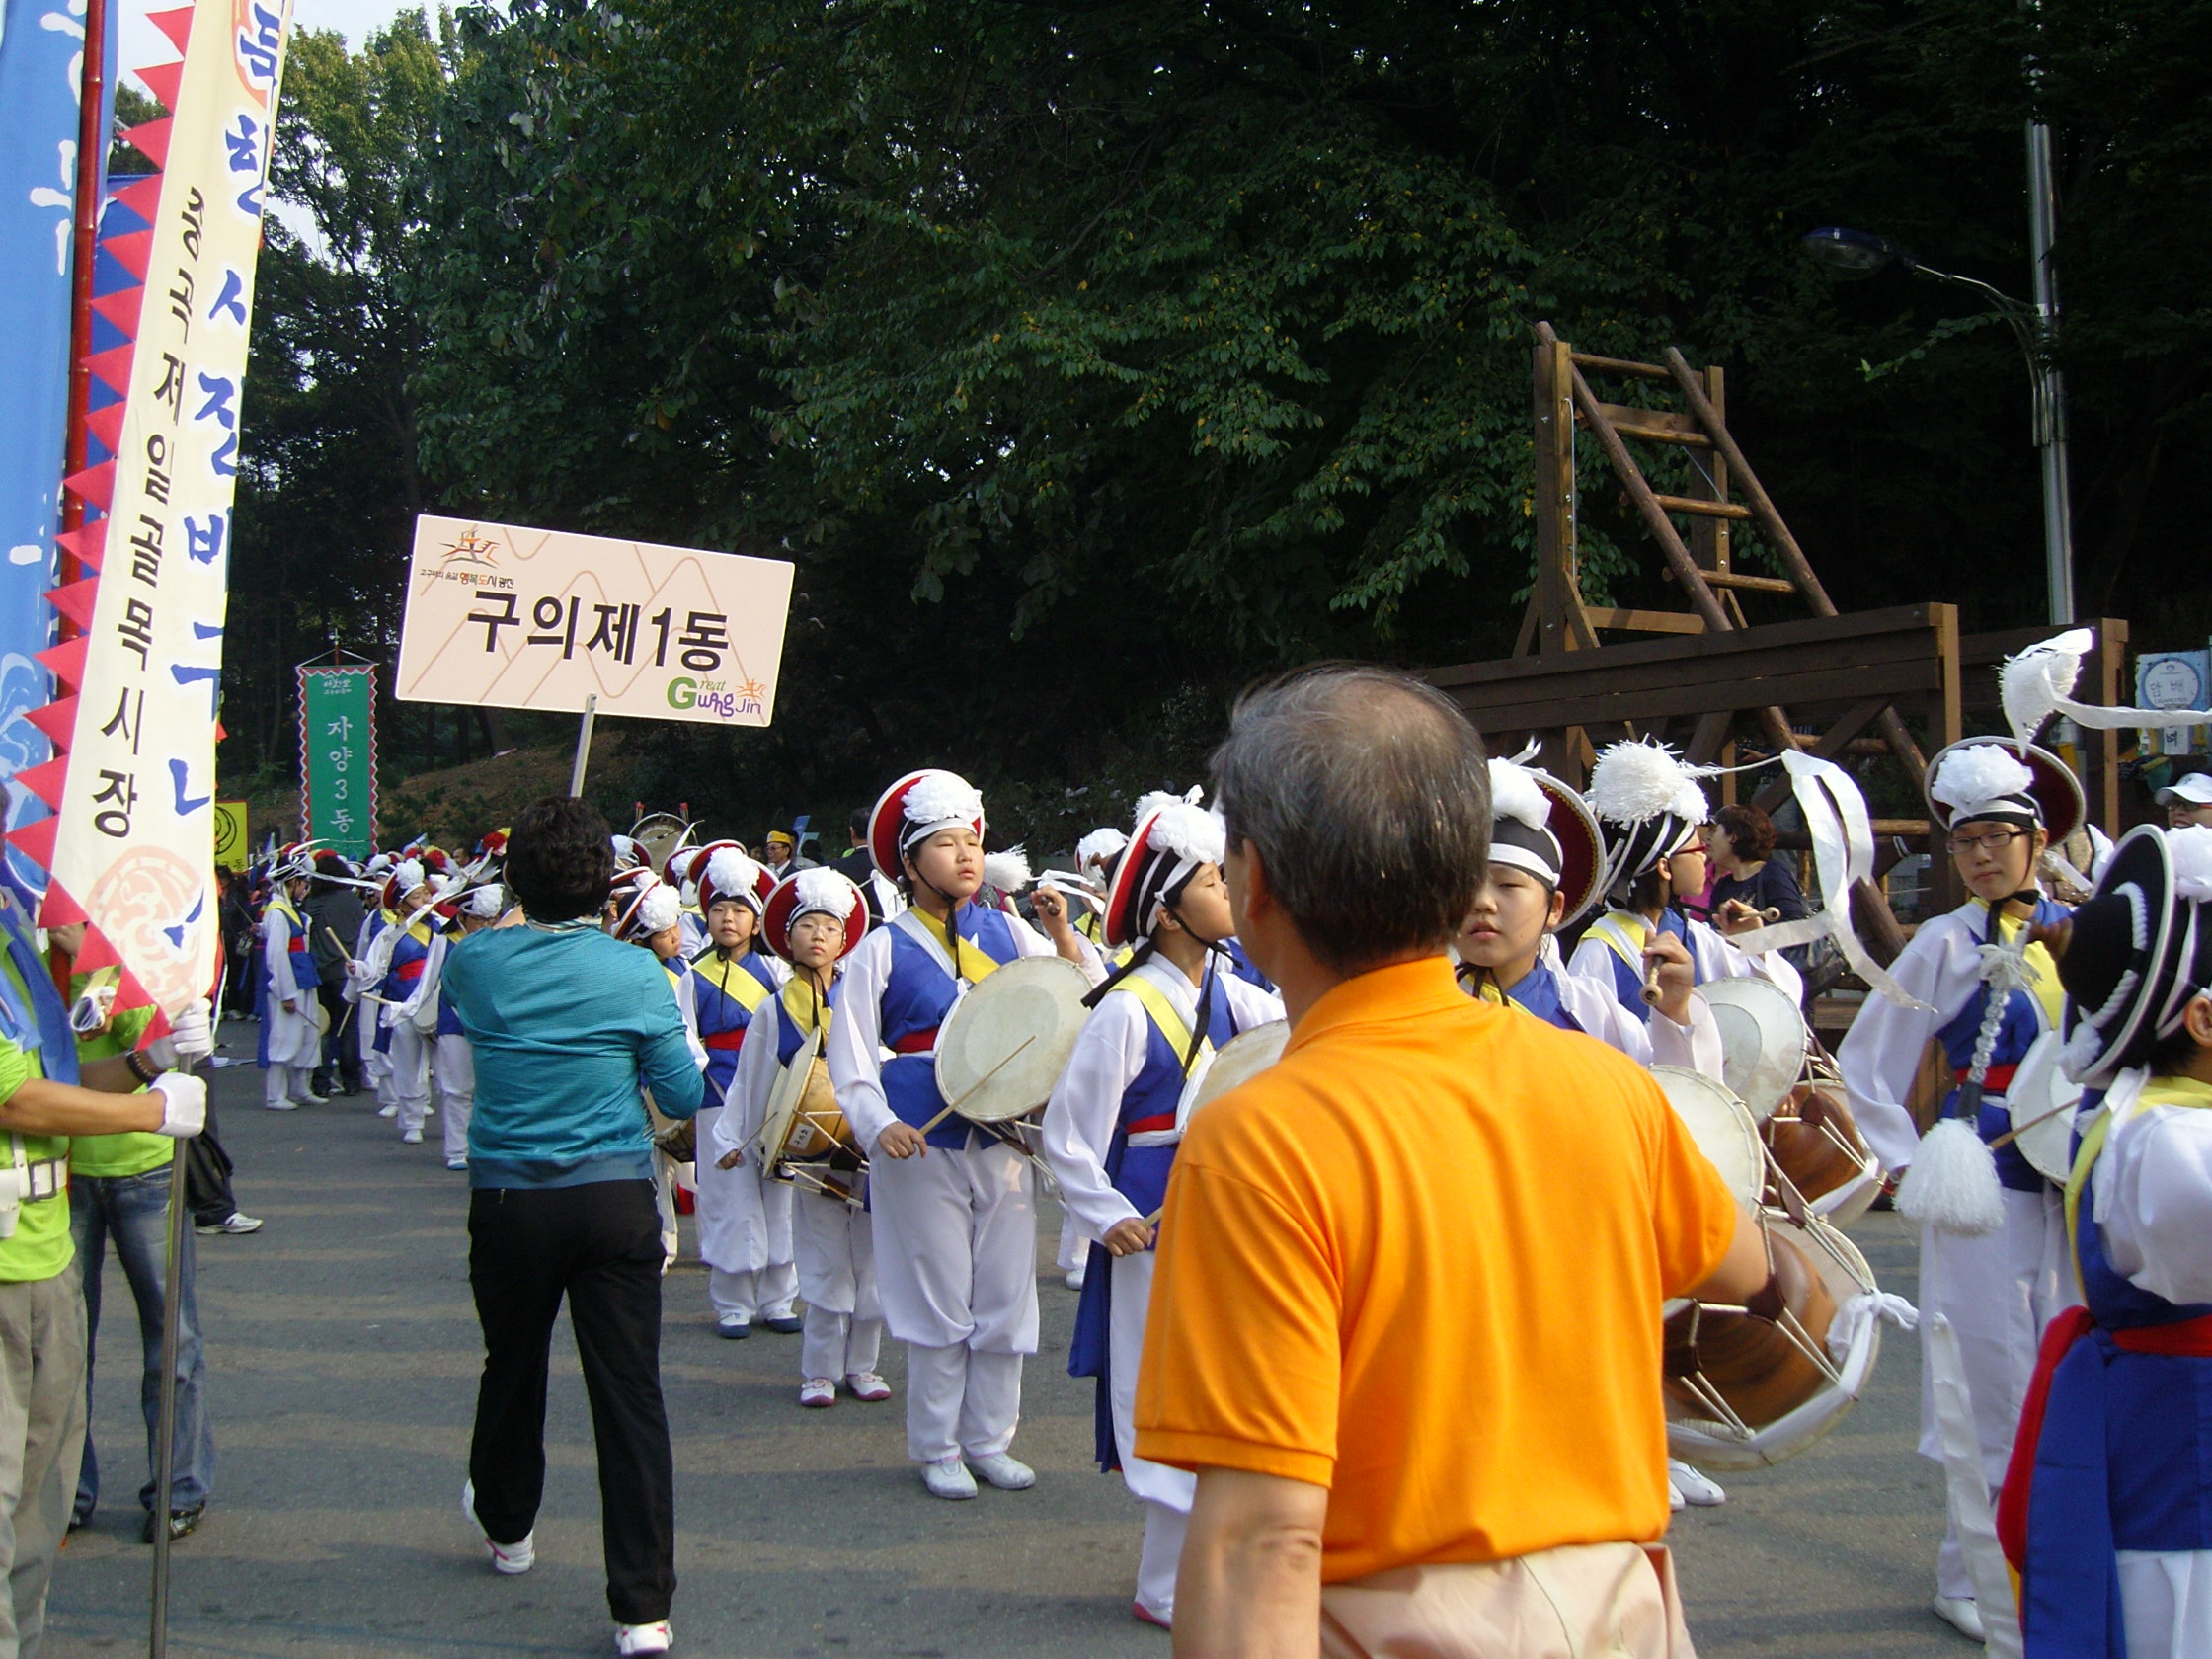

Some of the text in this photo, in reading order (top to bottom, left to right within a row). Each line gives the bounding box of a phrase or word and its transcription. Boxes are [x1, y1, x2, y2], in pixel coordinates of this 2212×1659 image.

[459, 571, 497, 589] 행복도시
[467, 590, 729, 672] 구의제1동
[327, 716, 355, 833] 자양3동
